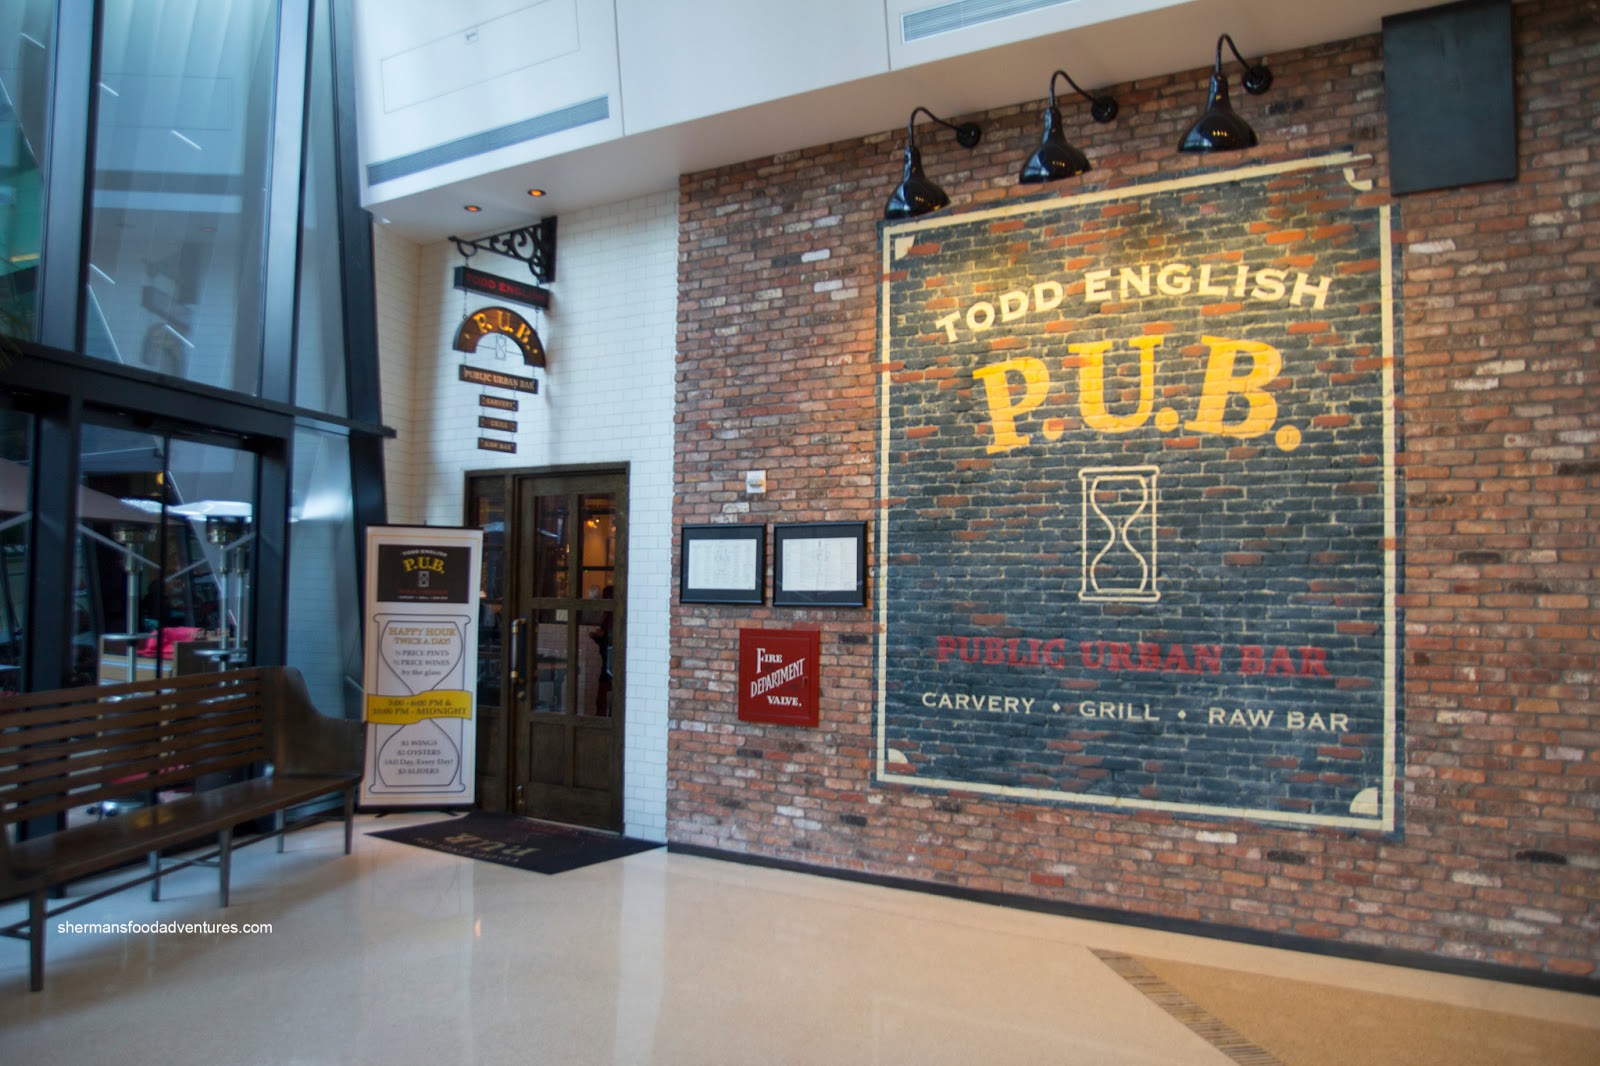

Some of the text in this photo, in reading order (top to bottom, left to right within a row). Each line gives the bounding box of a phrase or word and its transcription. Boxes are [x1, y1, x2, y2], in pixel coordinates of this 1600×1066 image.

[933, 263, 1333, 343] TODD ENGLISH
[463, 369, 535, 390] PUBLIC URBAN BAR
[972, 334, 1303, 455] P.U.B.
[388, 627, 456, 637] HAPPY HOUR
[394, 637, 421, 645] TWICE
[756, 647, 783, 674] FIRE
[935, 635, 1333, 678] PUBLIC URBAN BAR
[750, 657, 806, 698] DEPARTMENT
[394, 707, 409, 715] PM
[416, 707, 467, 715] MIDNIGHT
[429, 698, 443, 706] PM
[921, 691, 1350, 732] CARVERY GRILL RAW BAR
